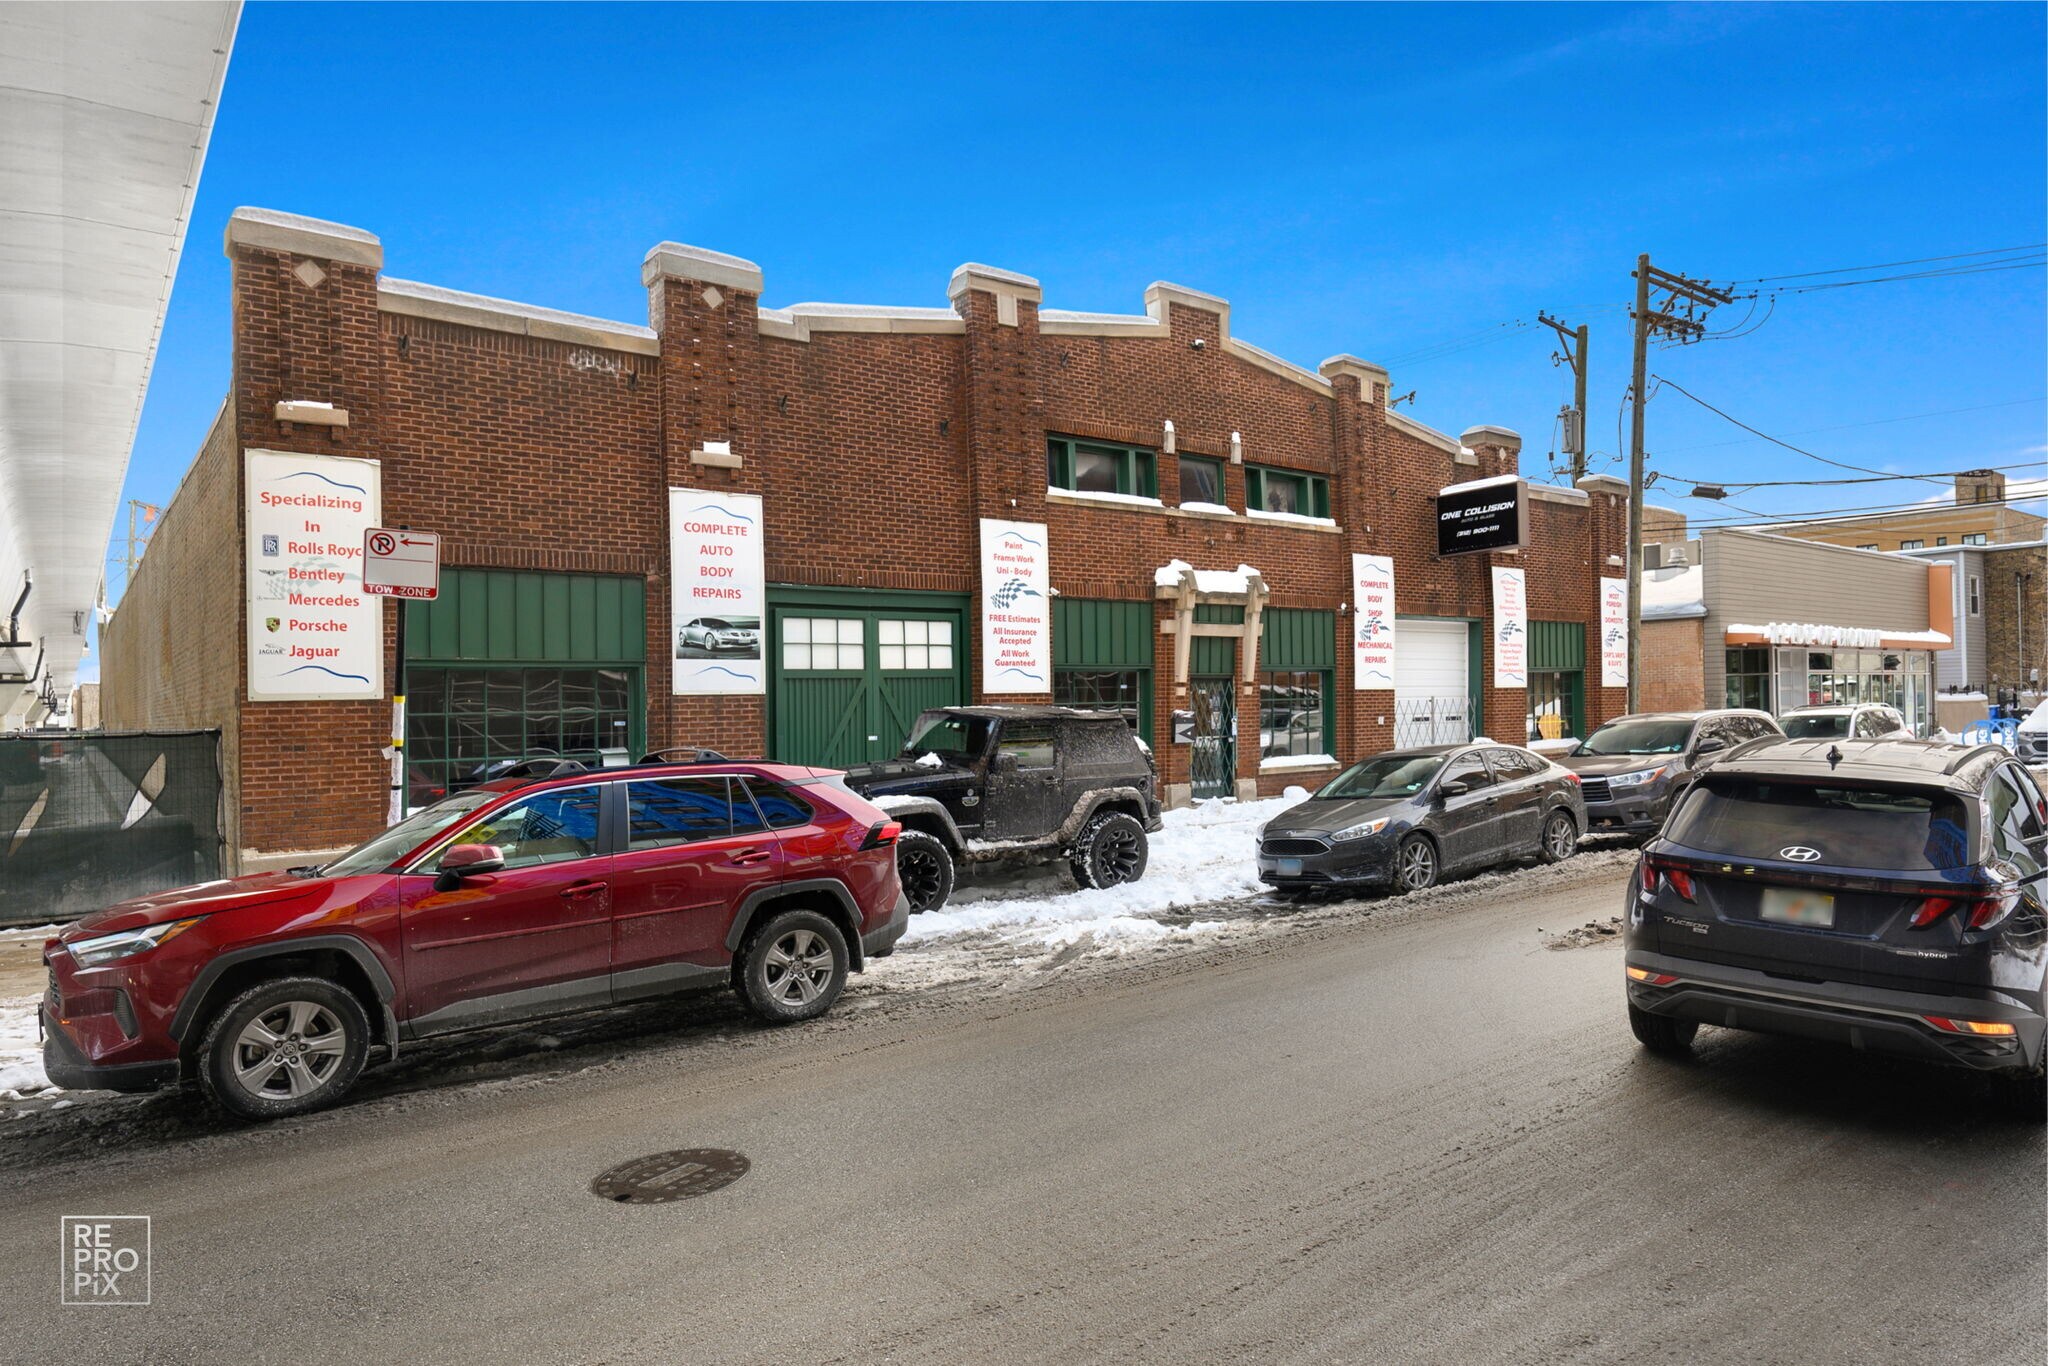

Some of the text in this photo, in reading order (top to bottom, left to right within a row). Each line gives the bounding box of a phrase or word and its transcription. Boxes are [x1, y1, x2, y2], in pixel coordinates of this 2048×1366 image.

[260, 491, 362, 512] Specializing
[1441, 500, 1515, 520] ONE COLLISION
[305, 520, 321, 532] In
[684, 522, 748, 536] COMPLETE
[288, 542, 362, 559] Rolls Royc
[700, 545, 733, 556] AUTO
[1004, 541, 1023, 550] Paint
[993, 553, 1035, 563] Frame Work
[289, 567, 345, 584] Bentley
[700, 566, 734, 577] BODY
[996, 566, 1009, 574] Uni
[1014, 567, 1032, 577] Body
[368, 584, 431, 597] TOW ZONE
[1360, 580, 1389, 589] COMPLETE
[693, 587, 742, 599] REPAIRS
[289, 593, 360, 606] Mercedes
[989, 614, 1040, 623] FREE Estimates
[289, 619, 347, 632] Porsche
[993, 627, 1037, 636] All Insurance
[1000, 637, 1031, 645] Accepted
[289, 645, 340, 660] Jaguar
[1918, 950, 1948, 960] hybrid
